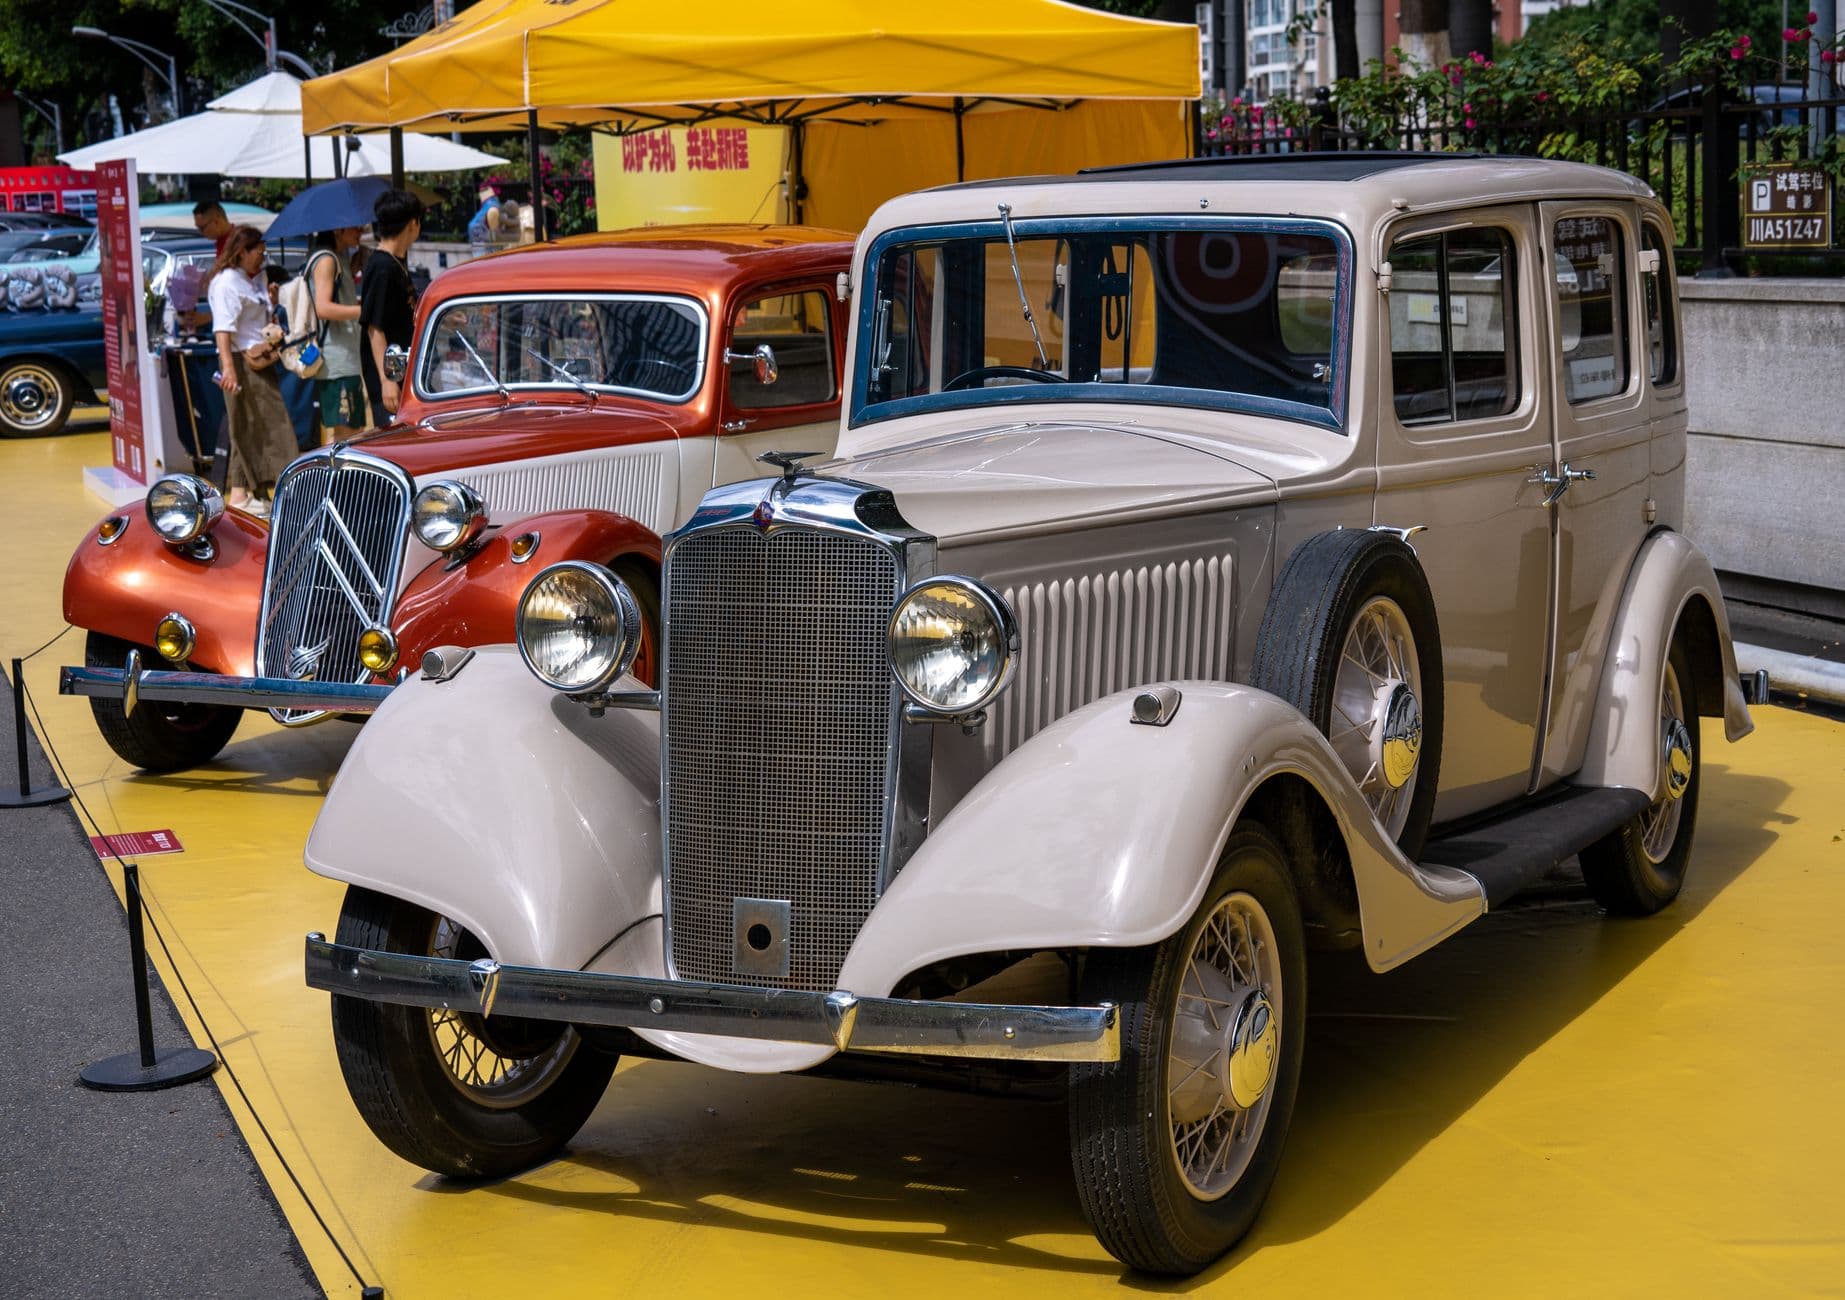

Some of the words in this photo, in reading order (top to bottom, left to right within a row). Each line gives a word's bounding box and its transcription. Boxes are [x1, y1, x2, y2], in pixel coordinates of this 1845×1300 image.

[686, 128, 750, 171] 共赴新程
[1776, 171, 1824, 191] 试驾车位
[1756, 183, 1768, 209] P
[1750, 218, 1822, 242] 川A51Z47
